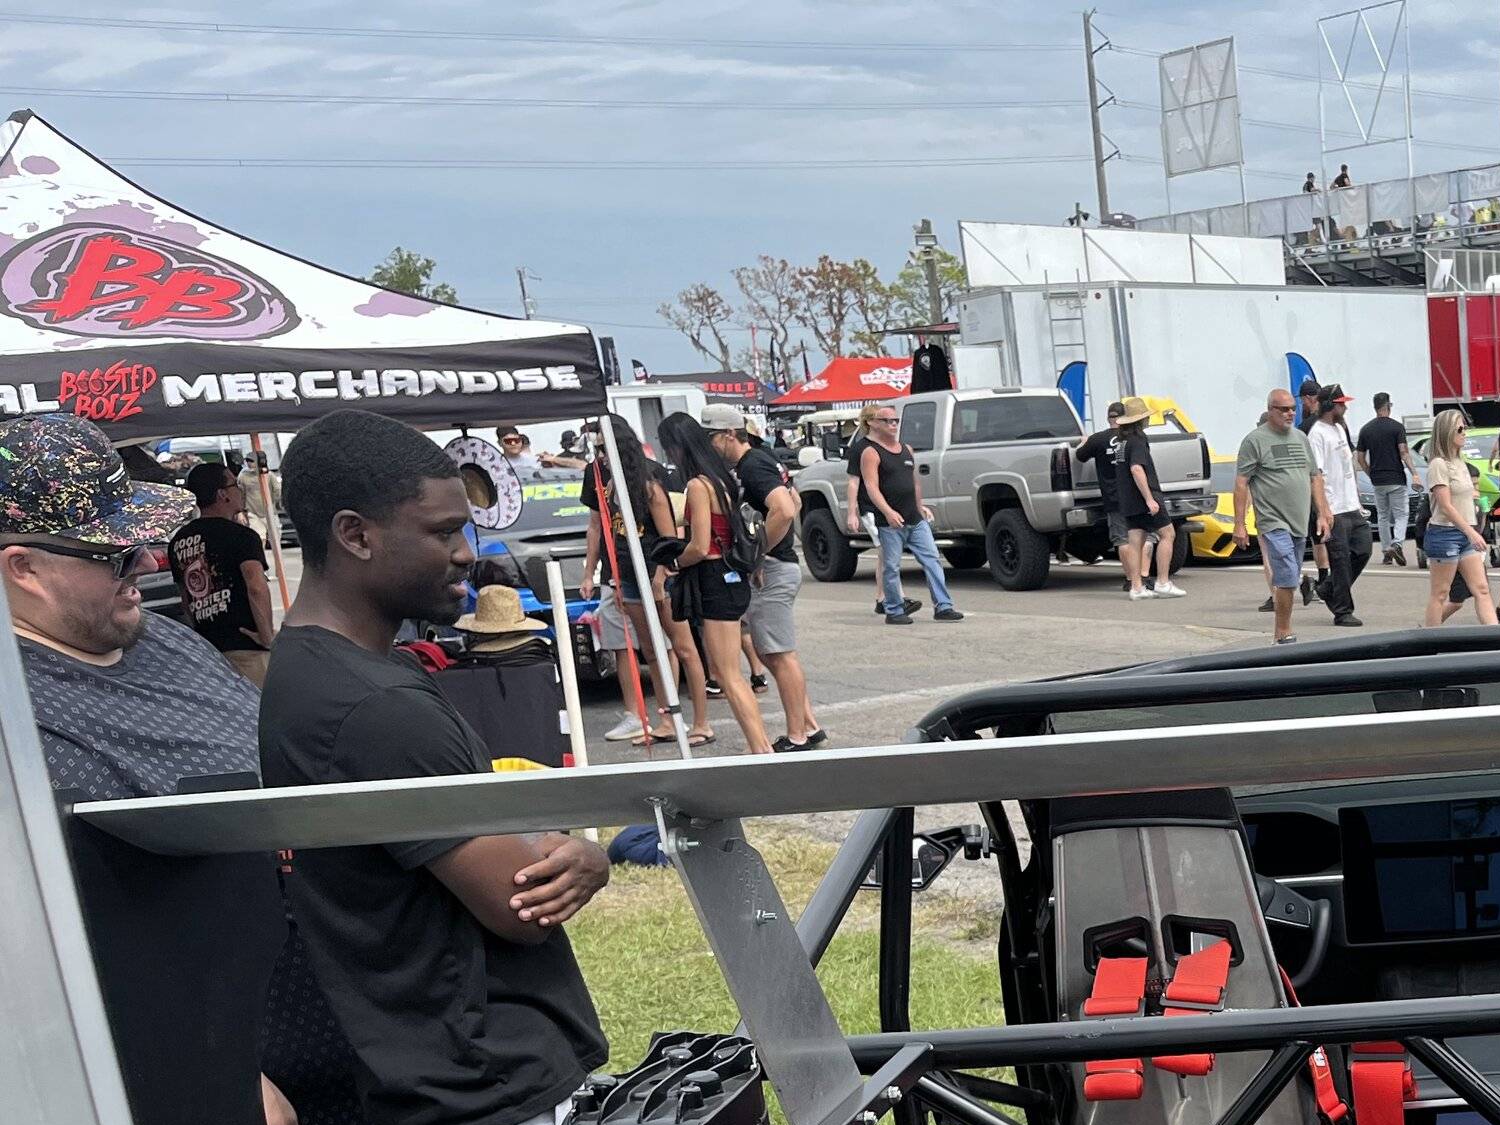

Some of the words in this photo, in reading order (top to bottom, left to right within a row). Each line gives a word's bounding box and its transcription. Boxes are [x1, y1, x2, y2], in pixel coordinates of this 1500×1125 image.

[31, 235, 242, 330] BB
[57, 359, 157, 403] BOOSTED
[162, 363, 582, 408] MERCHANDISE
[174, 534, 202, 552] GOOD
[175, 541, 206, 562] VIBES
[194, 600, 228, 624] RIDES
